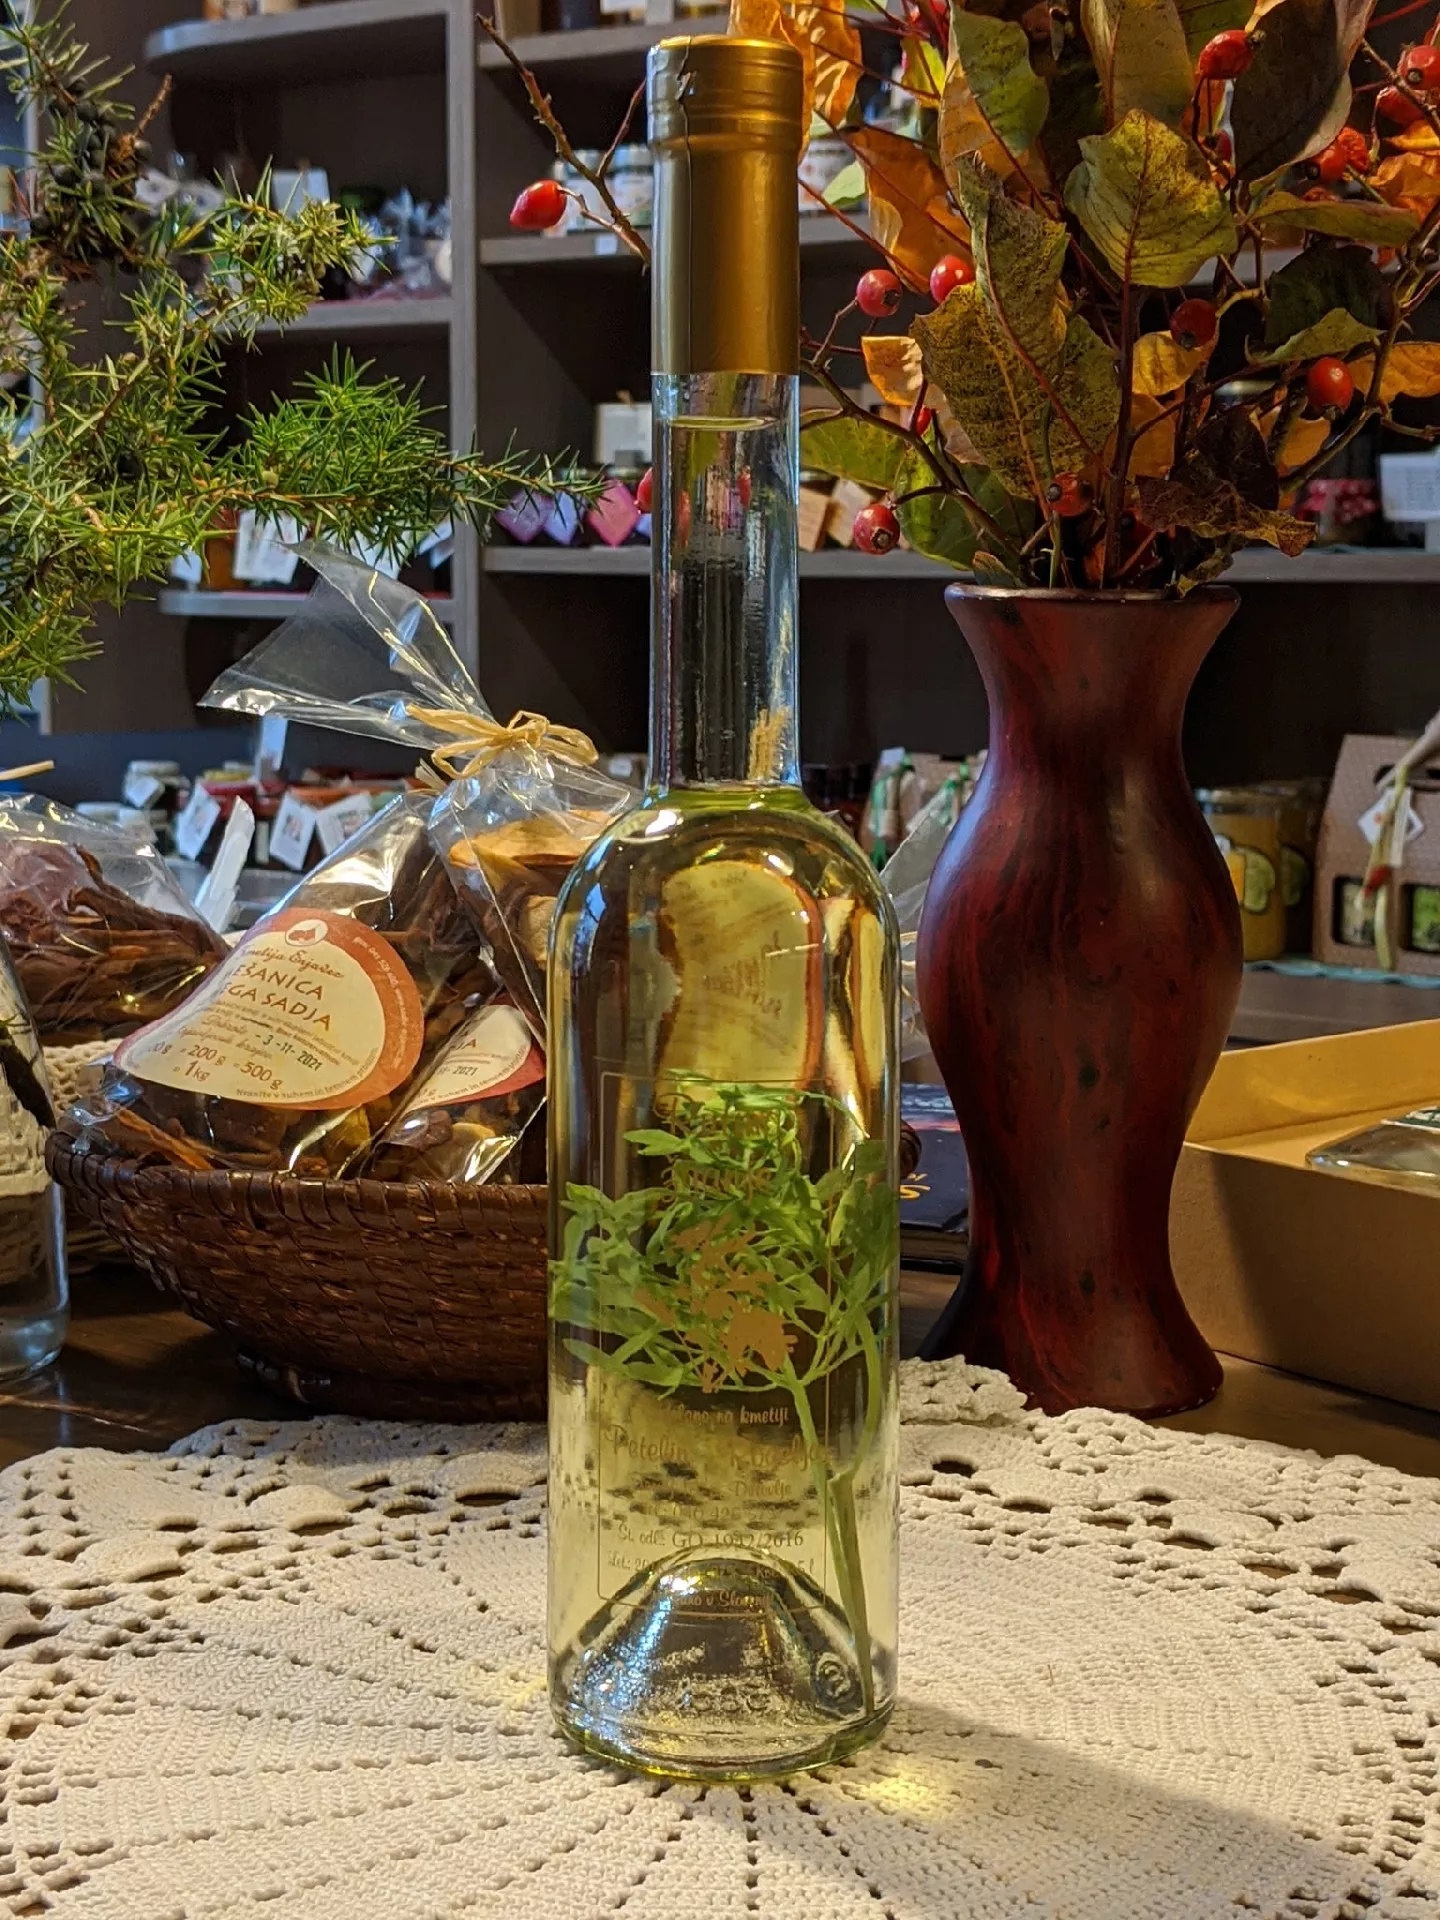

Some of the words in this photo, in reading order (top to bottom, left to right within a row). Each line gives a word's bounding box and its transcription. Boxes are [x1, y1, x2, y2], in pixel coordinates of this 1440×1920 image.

[230, 962, 323, 1000] EŠANICA
[261, 993, 331, 1031] SADJA
[187, 1044, 218, 1061] 200
[239, 1061, 273, 1082] 500
[297, 1050, 323, 1072] 2021
